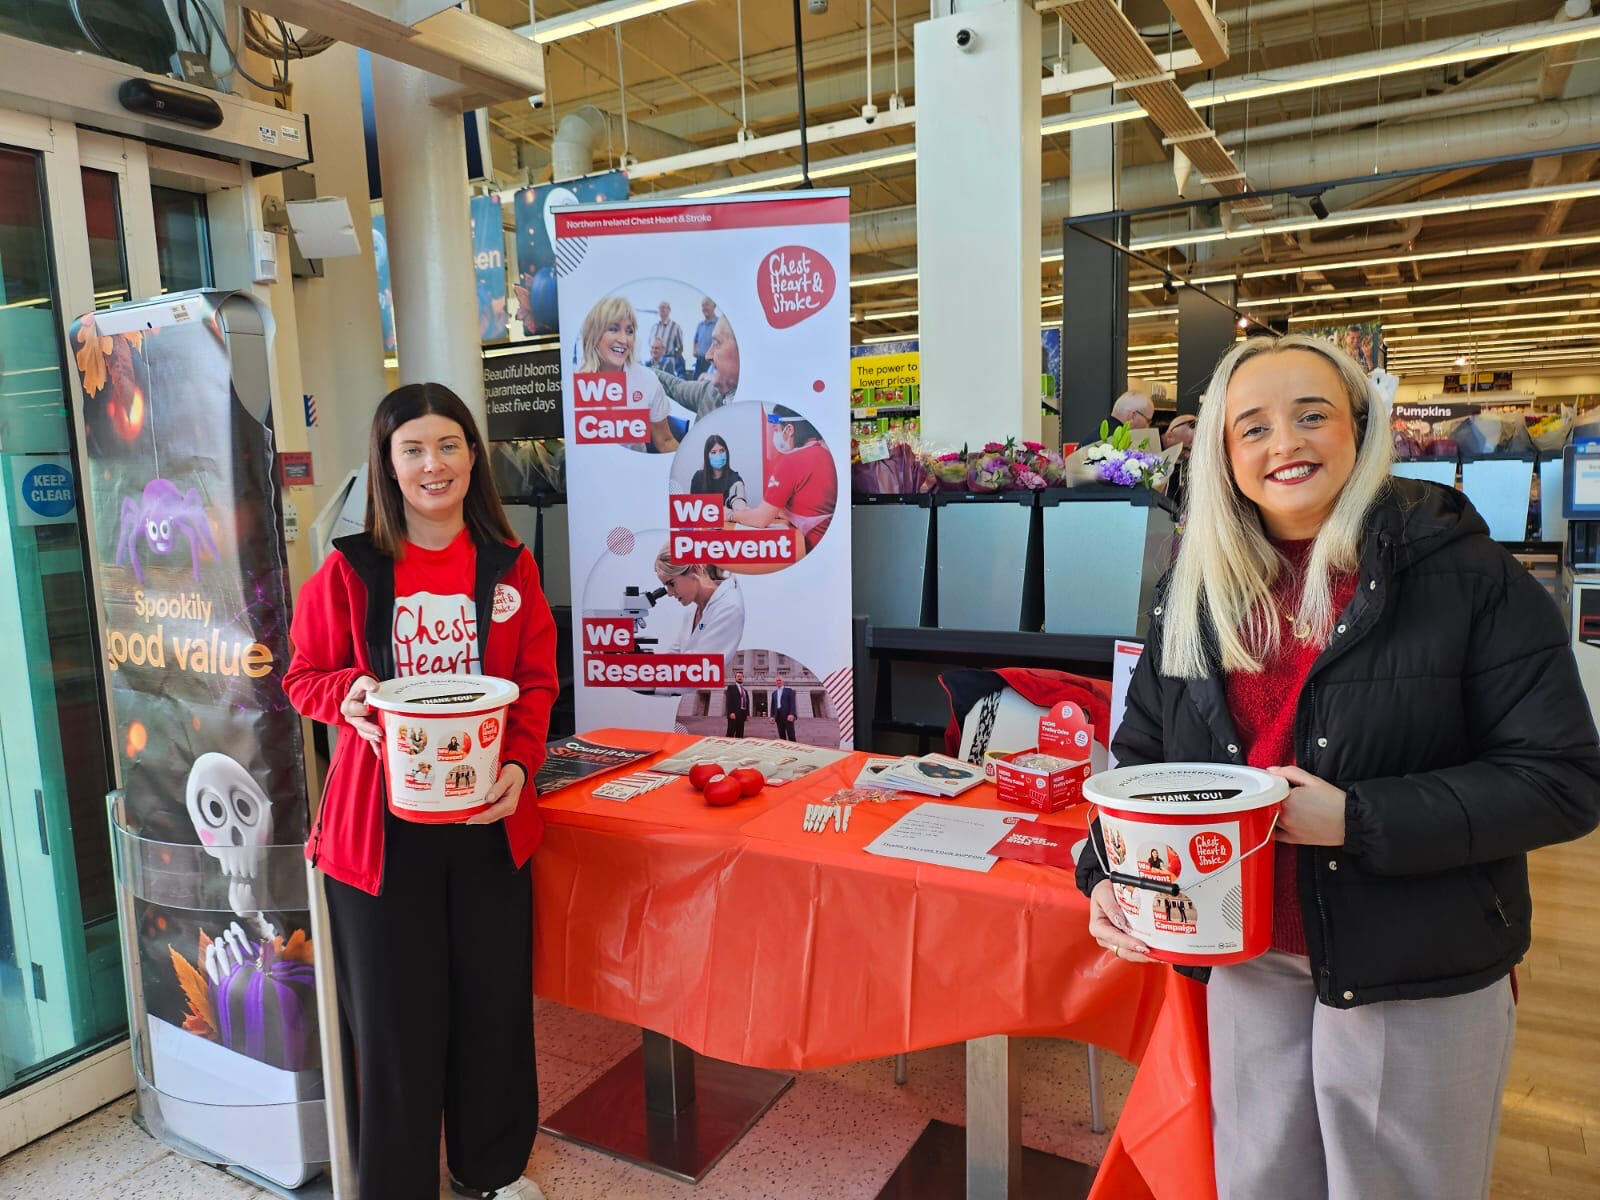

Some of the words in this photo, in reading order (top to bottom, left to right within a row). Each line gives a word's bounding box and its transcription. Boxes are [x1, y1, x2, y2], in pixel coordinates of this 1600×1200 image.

[567, 219, 601, 229] Northern
[603, 217, 630, 227] Ireland
[631, 216, 655, 225] Chest
[655, 215, 678, 224] Heart
[686, 214, 712, 222] Stroke
[769, 252, 811, 276] Chest
[770, 273, 812, 293] Heart
[812, 272, 824, 293] &
[773, 292, 820, 313] Stroke
[484, 364, 523, 381] Beautiful
[524, 362, 560, 377] blooms
[857, 367, 874, 376] The
[876, 364, 905, 376] power
[908, 363, 918, 372] to
[535, 382, 545, 393] to
[547, 378, 561, 392] las
[577, 378, 623, 401] We
[859, 377, 885, 387] lower
[887, 375, 916, 388] prices
[492, 400, 512, 413] least
[514, 398, 531, 412] five
[532, 397, 556, 413] days
[1396, 406, 1452, 418] Pumpkins
[579, 415, 646, 439] Care
[33, 474, 66, 486] KEEP
[31, 489, 71, 502] CLEAR
[674, 500, 719, 523] We
[674, 535, 792, 559] Prevent
[135, 590, 213, 627] Spookily
[394, 605, 477, 645] Chest
[586, 624, 631, 646] We
[172, 629, 274, 678] value
[394, 643, 481, 678] Heart
[588, 659, 720, 682] Research
[565, 742, 606, 755] Could
[1152, 793, 1190, 802] THANK
[1194, 791, 1222, 800] YOU!
[1195, 835, 1219, 848] Chest
[1197, 845, 1220, 856] Heart
[1199, 855, 1225, 866] Stroke
[1155, 921, 1196, 934] Campaign
